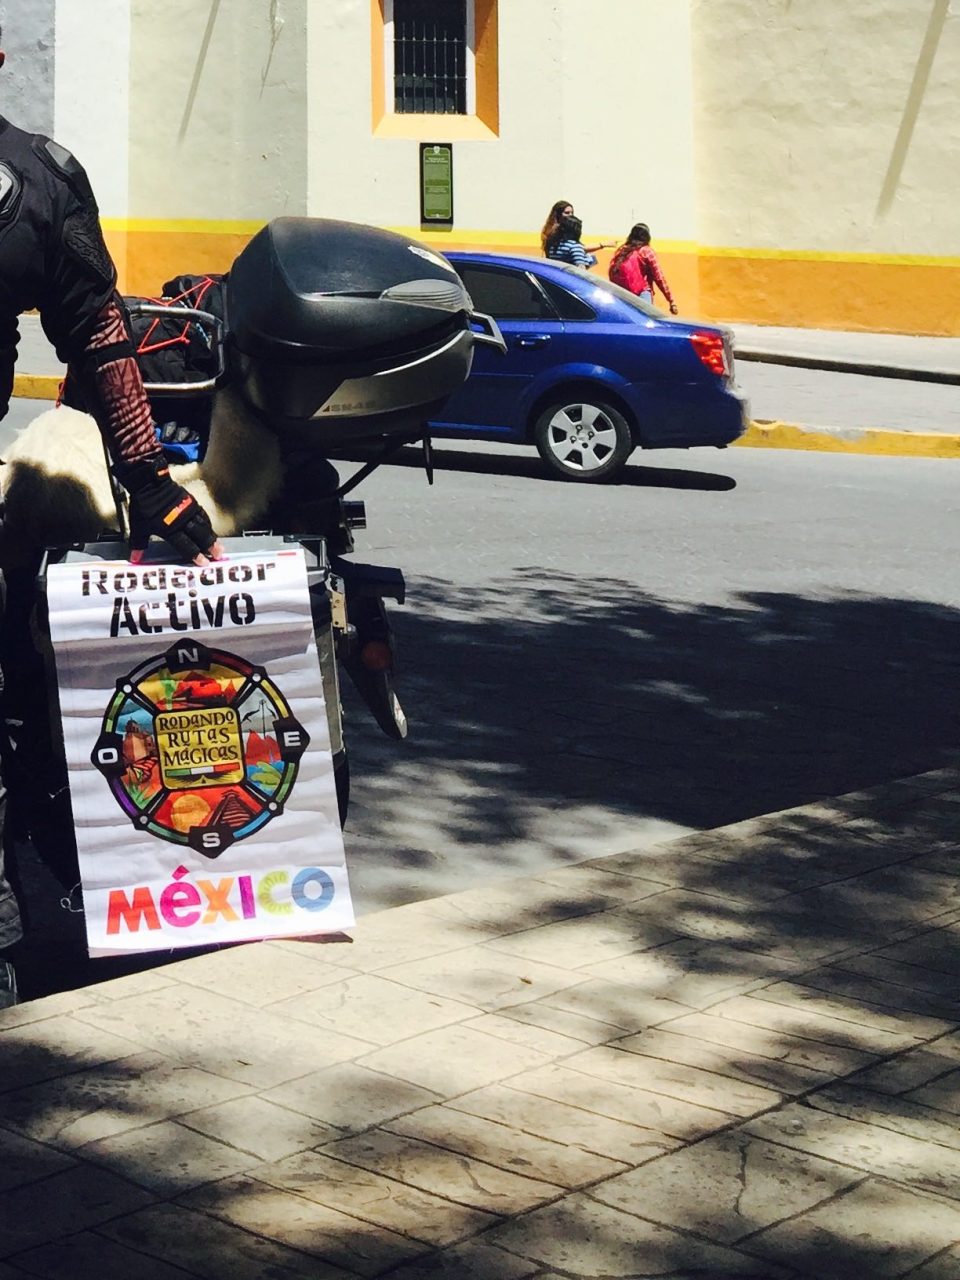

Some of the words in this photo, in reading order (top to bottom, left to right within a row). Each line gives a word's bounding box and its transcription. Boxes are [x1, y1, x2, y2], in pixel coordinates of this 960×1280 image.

[81, 562, 276, 596] Rodador
[109, 591, 256, 637] Activo
[177, 648, 199, 663] N
[283, 730, 300, 746] E
[202, 832, 221, 847] S
